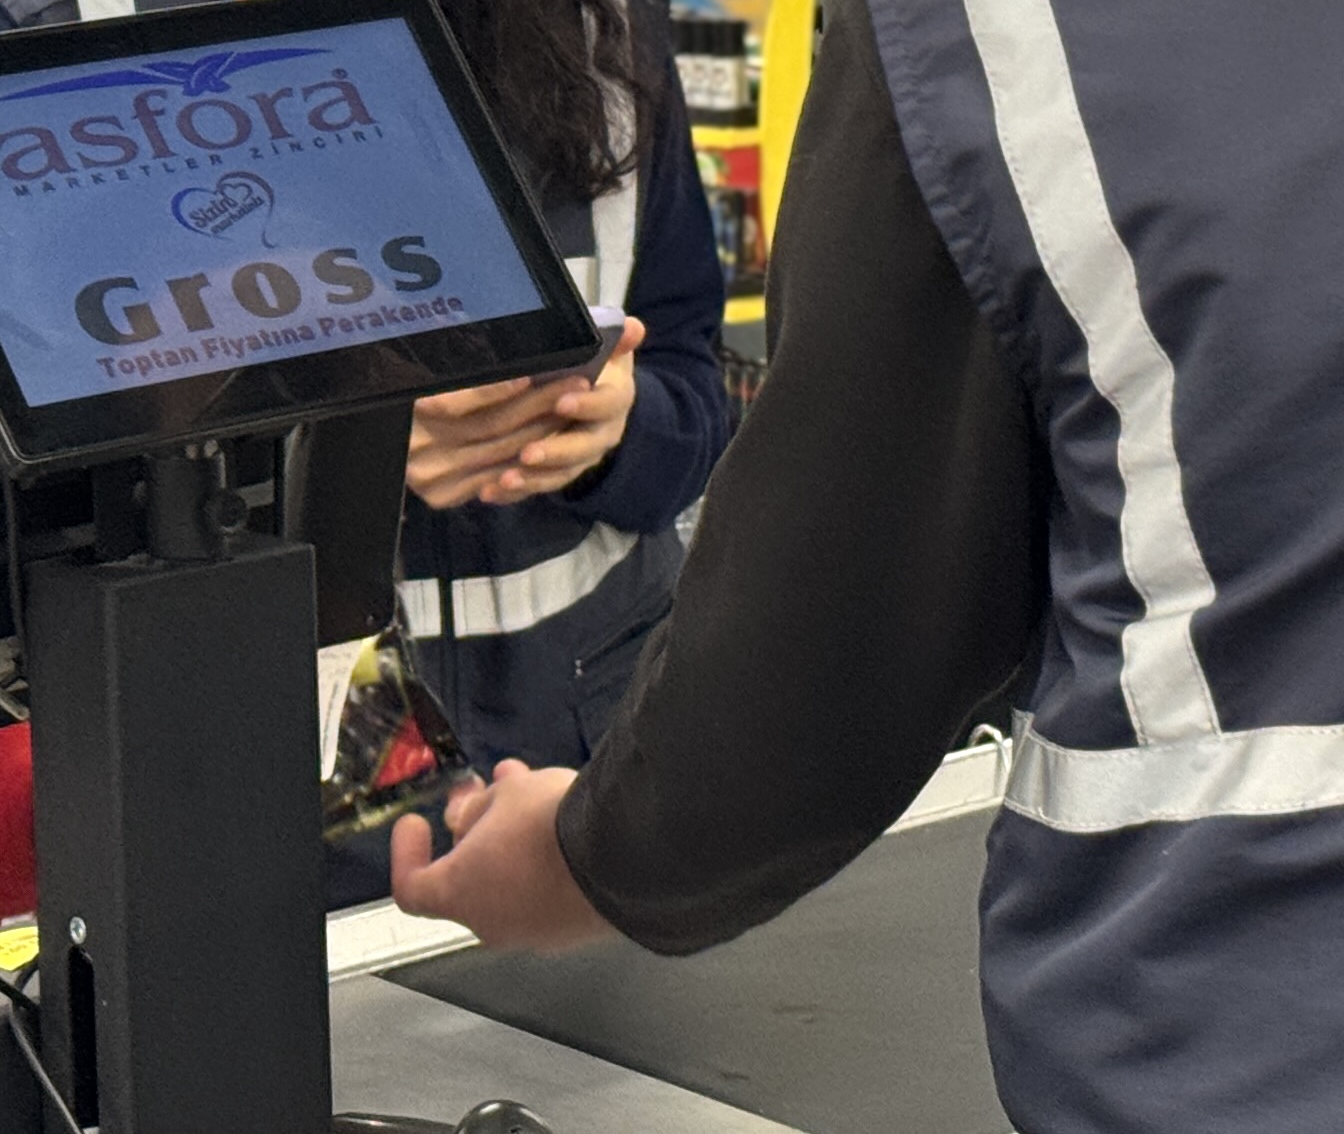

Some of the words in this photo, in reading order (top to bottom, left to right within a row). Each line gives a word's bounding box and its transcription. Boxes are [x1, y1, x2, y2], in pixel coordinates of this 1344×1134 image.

[12, 153, 224, 197] MARKETLER
[96, 344, 199, 379] Toptan
[200, 323, 316, 360] Fiyatına
[317, 295, 465, 339] Perakende
